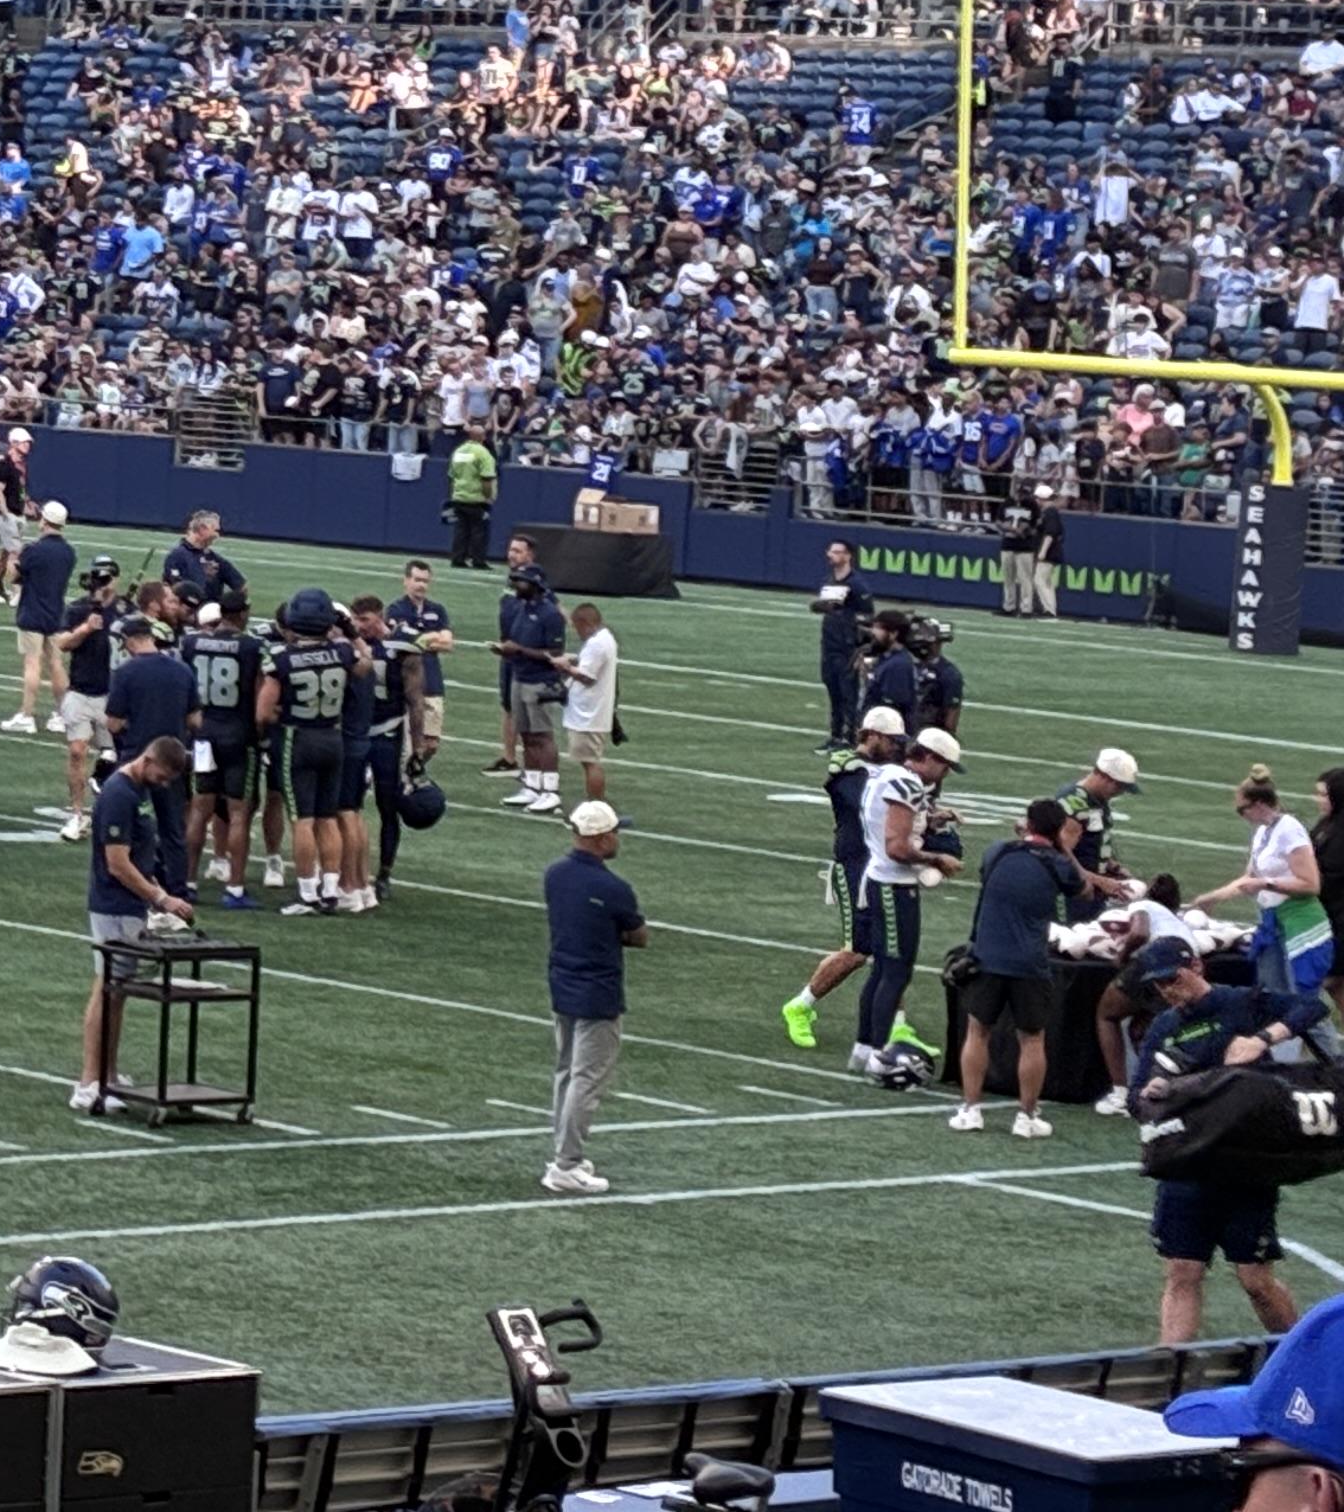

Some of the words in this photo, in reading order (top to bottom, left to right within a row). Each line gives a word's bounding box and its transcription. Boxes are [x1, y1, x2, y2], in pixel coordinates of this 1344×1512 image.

[1236, 485, 1266, 650] SEAHAWKS
[193, 655, 240, 708] 18
[964, 1477, 1013, 1512] TOWELS
